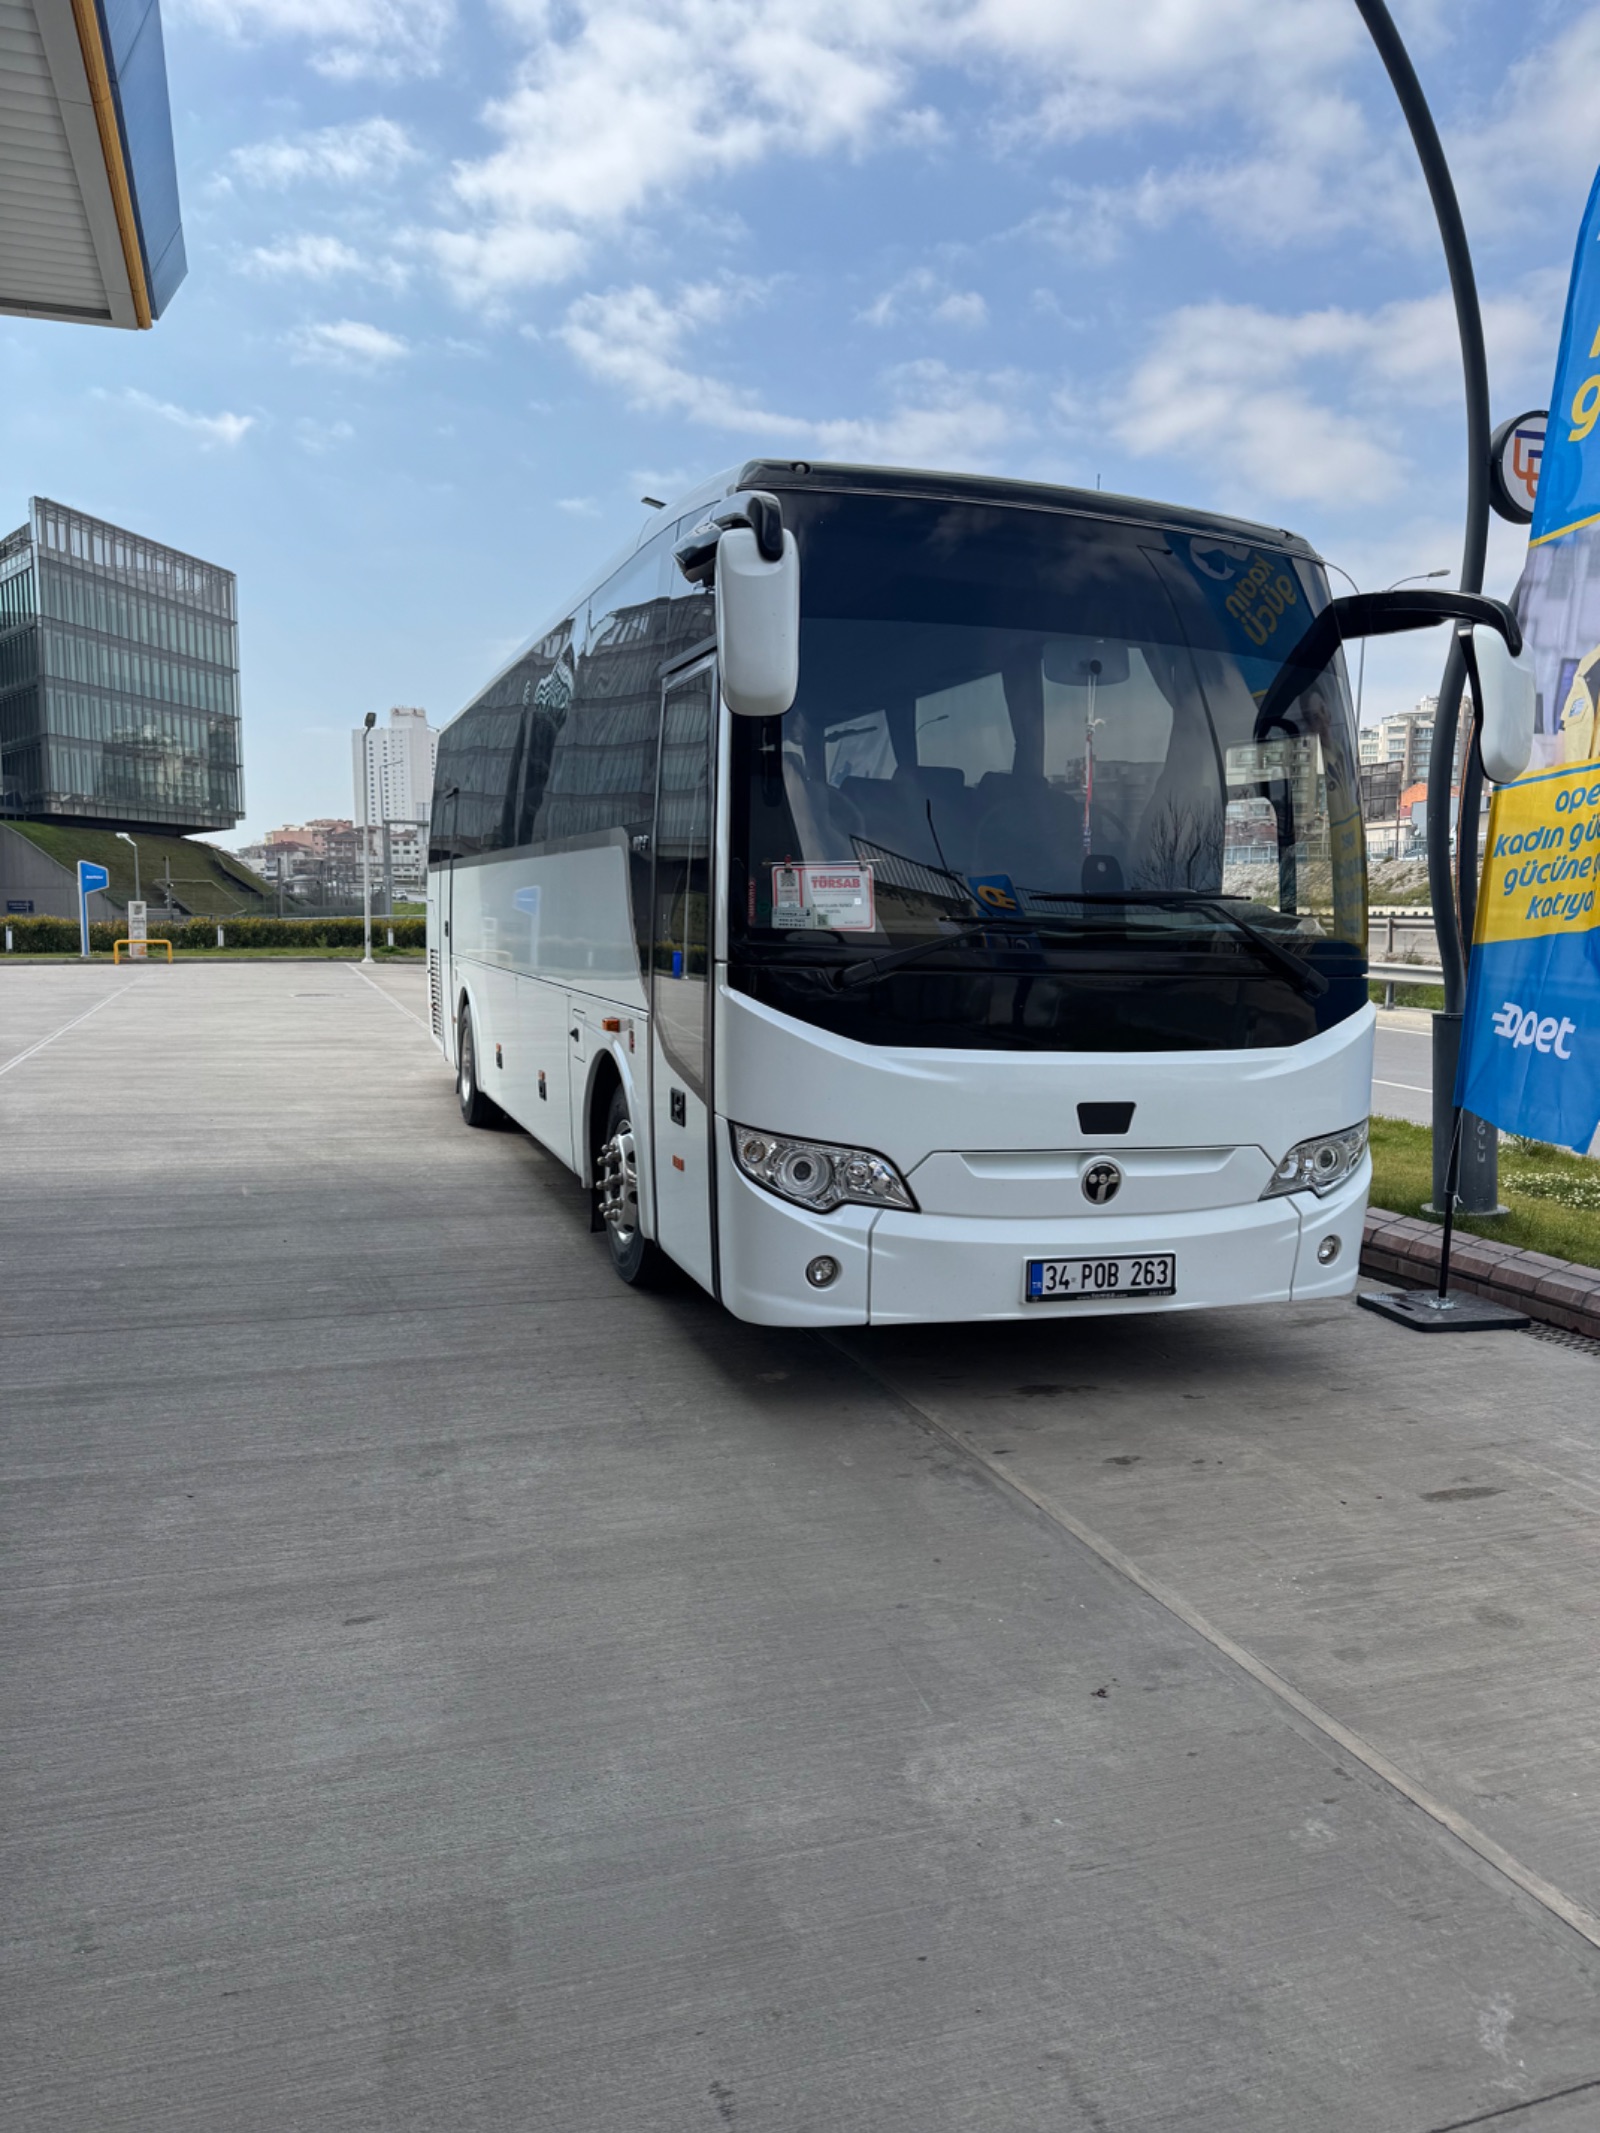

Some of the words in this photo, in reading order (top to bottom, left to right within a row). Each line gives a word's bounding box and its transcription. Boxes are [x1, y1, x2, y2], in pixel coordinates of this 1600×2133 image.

[1493, 825, 1565, 858] kadın
[811, 876, 861, 889] TÜRSAB
[1503, 854, 1592, 897] gücüne
[1045, 1264, 1071, 1291] 34
[1081, 1262, 1120, 1289] POB
[1130, 1259, 1169, 1286] 263
